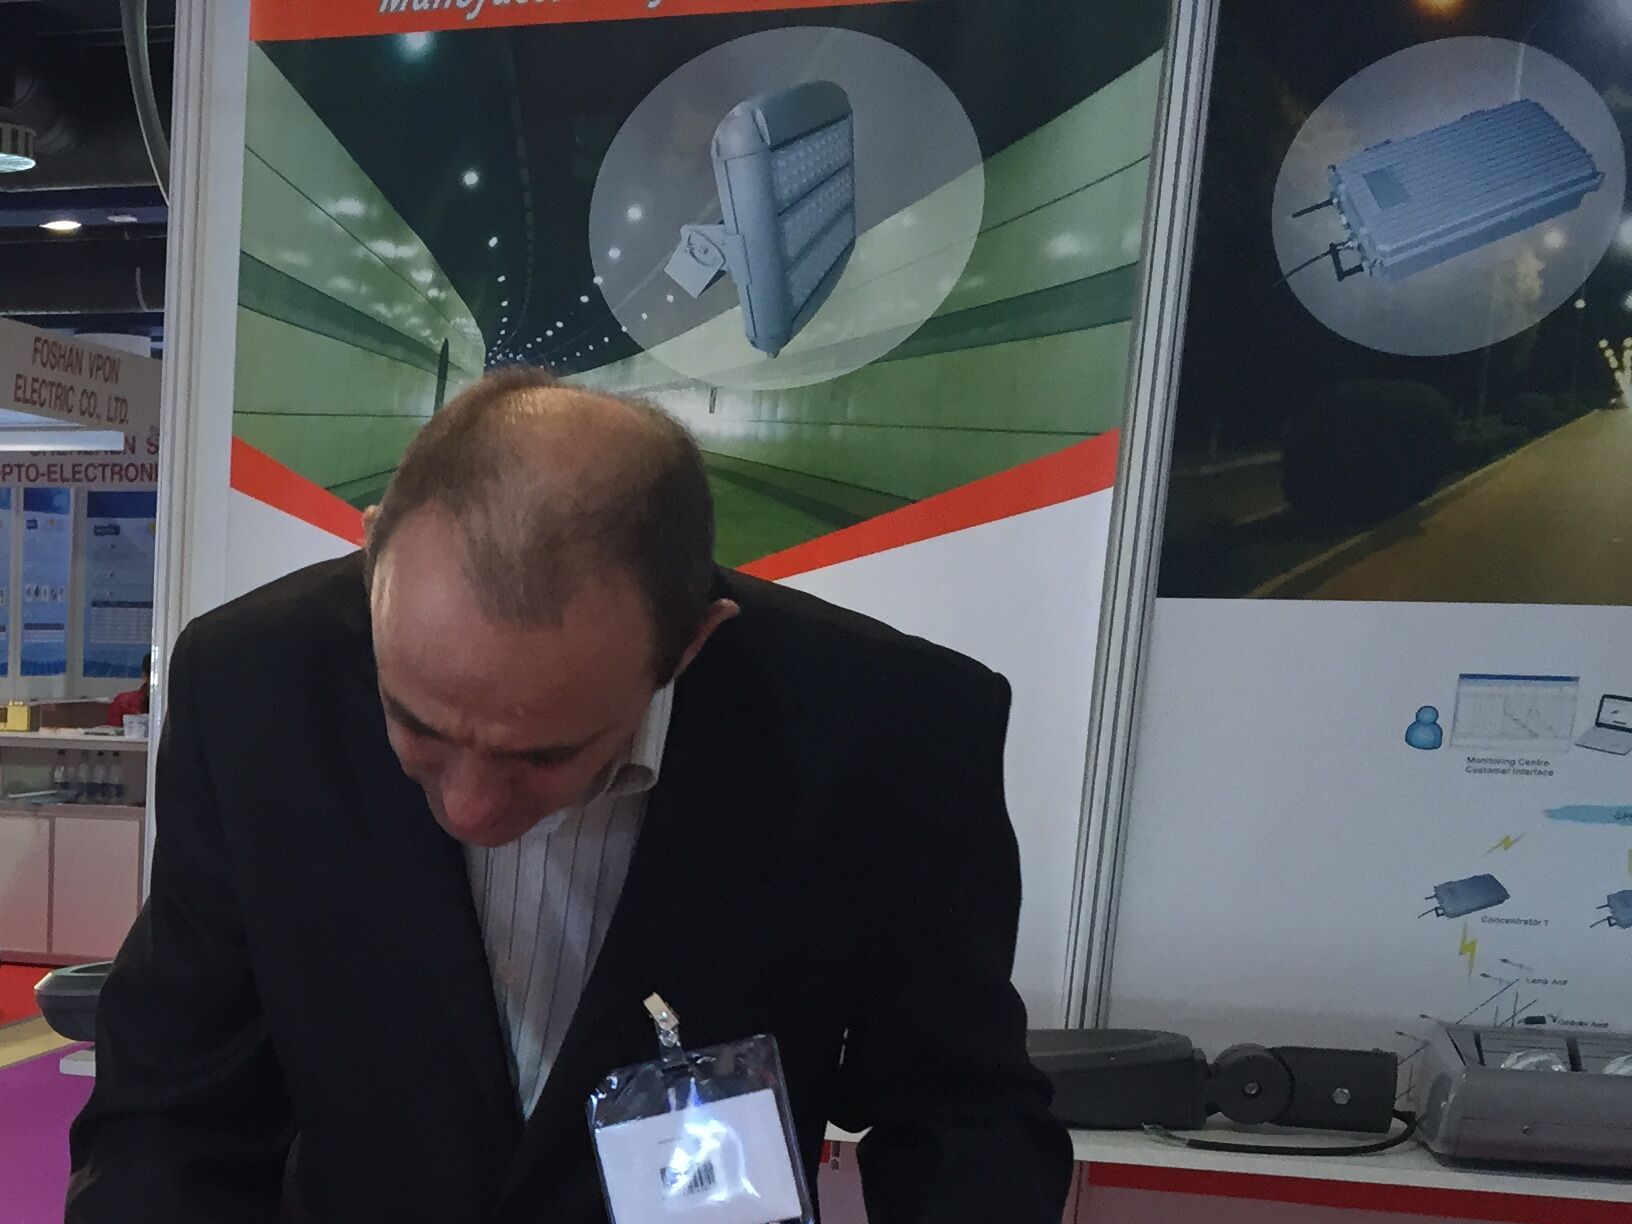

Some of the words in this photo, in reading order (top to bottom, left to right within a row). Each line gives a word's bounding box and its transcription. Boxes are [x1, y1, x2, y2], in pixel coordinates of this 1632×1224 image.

[32, 336, 84, 377] FOSHAN
[88, 351, 121, 384] VPON
[13, 373, 76, 414] ELECTRIC
[106, 395, 130, 425] LTD.
